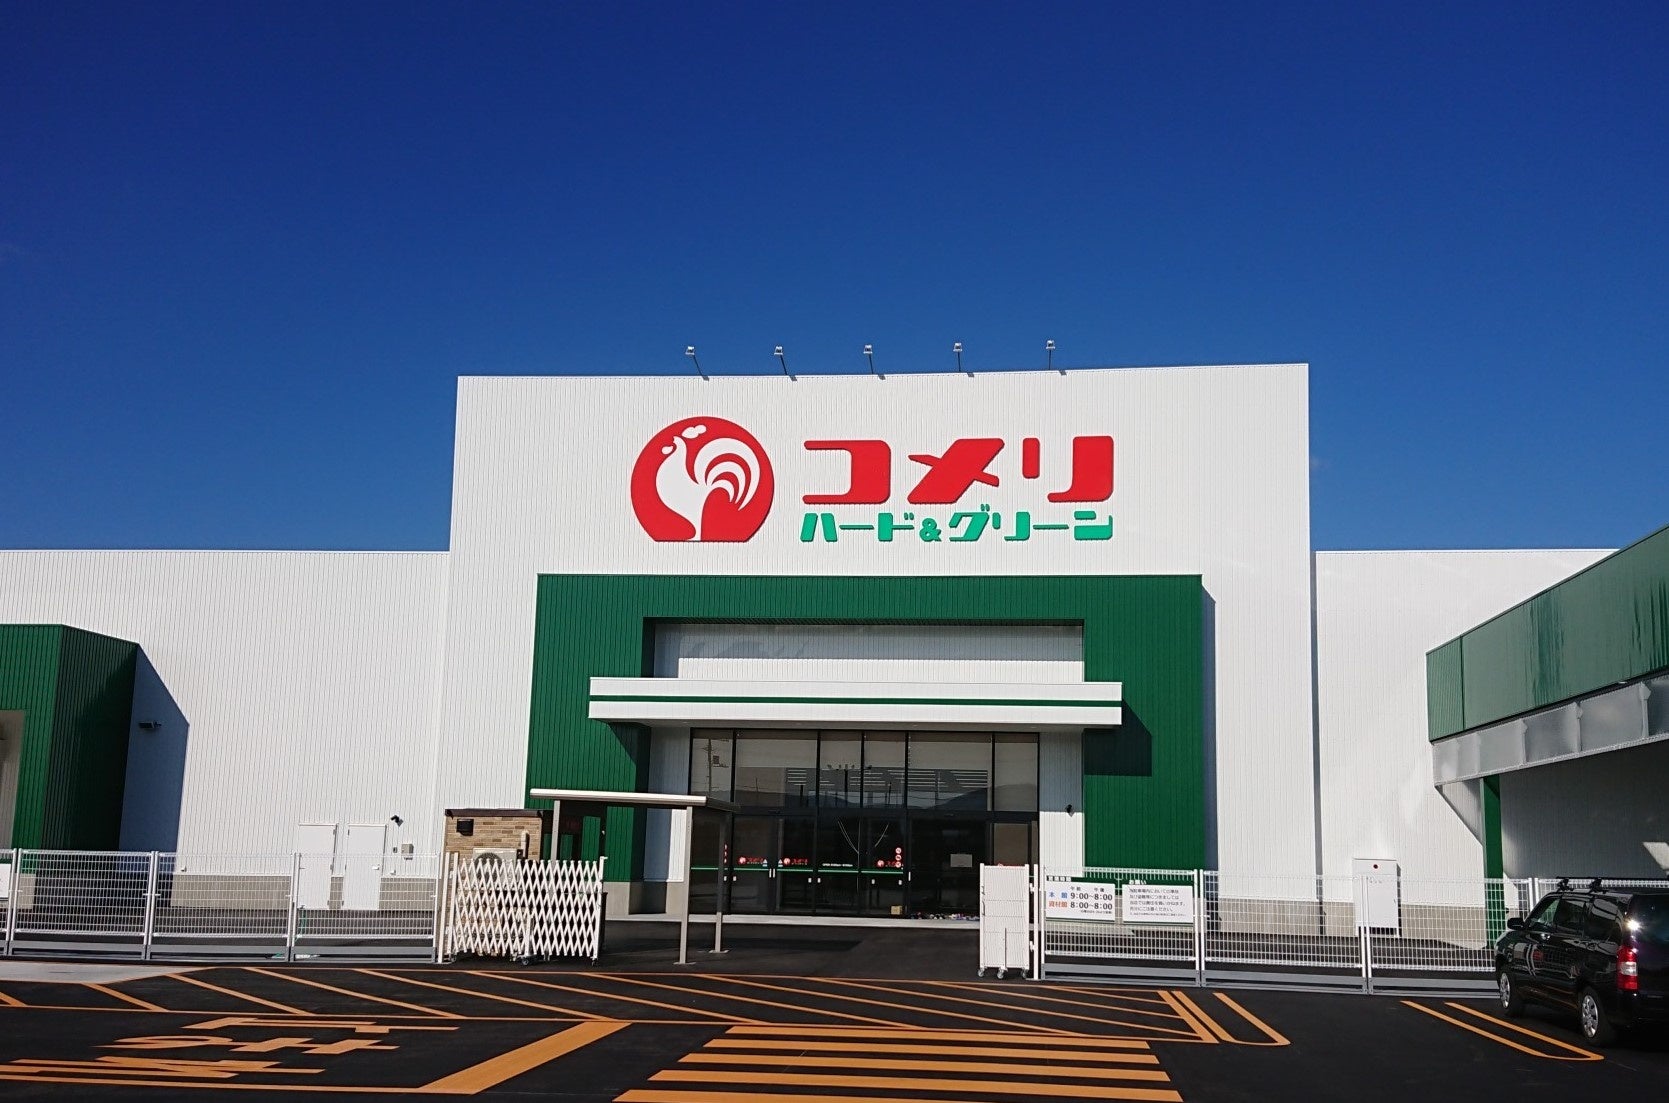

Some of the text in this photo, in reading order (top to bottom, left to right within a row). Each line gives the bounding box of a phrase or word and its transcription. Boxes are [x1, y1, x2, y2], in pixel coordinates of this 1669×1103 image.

[803, 436, 1114, 504] コメリ
[801, 505, 1113, 542] ハード&グリーン
